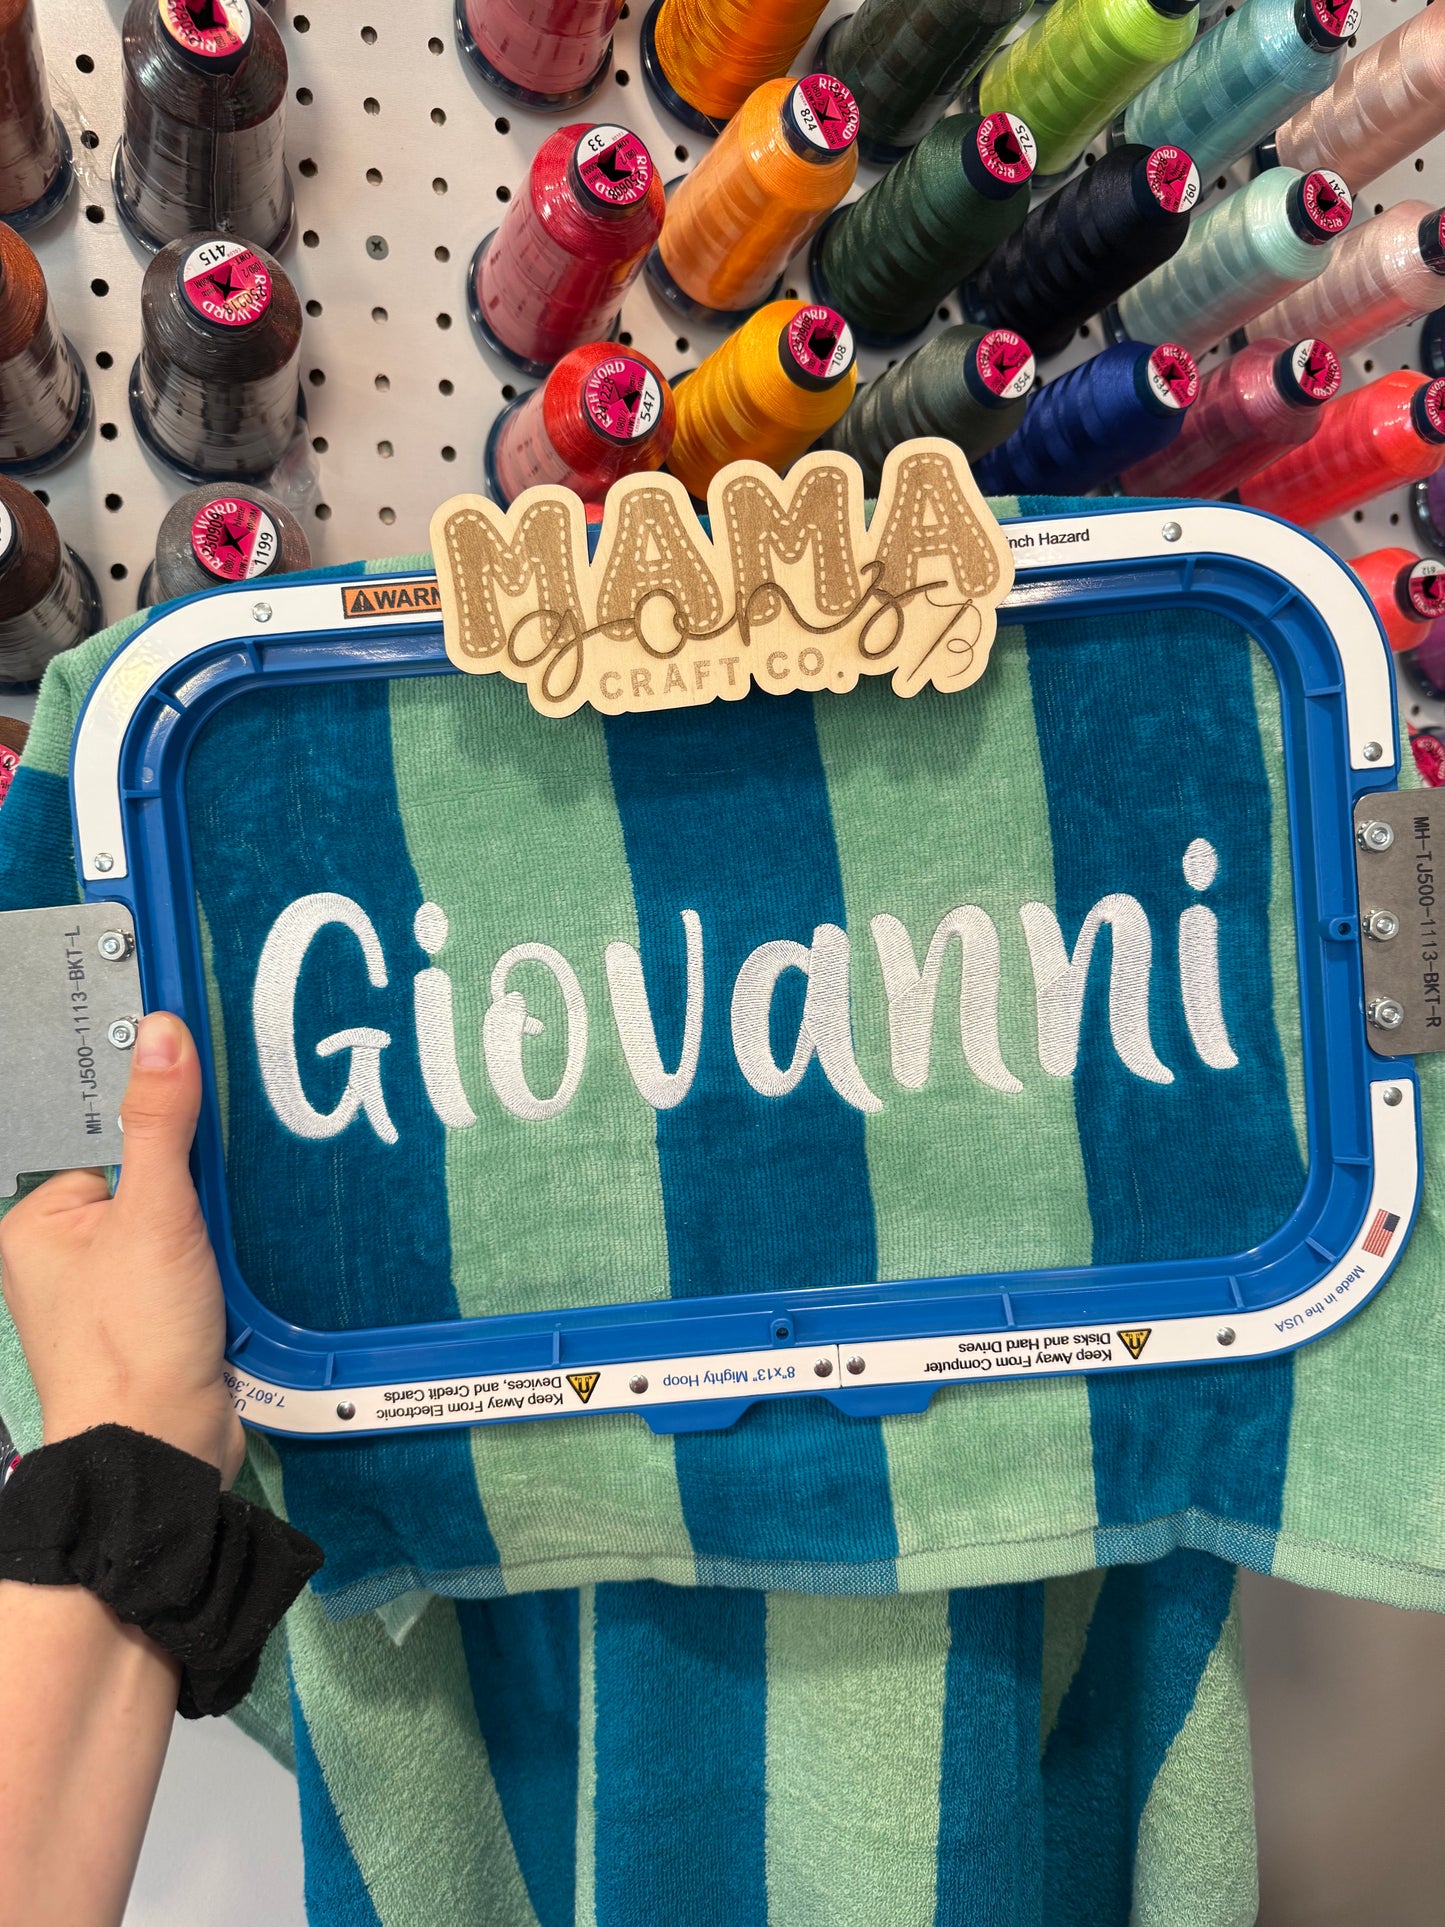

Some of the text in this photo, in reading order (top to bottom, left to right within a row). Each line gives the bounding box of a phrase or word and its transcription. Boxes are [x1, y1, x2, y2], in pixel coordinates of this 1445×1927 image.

[1345, 8, 1359, 30] 323
[800, 108, 818, 131] 824
[587, 134, 606, 152] 33
[1015, 124, 1033, 153] 725
[1183, 183, 1197, 205] 760
[1328, 179, 1346, 197] 247
[198, 244, 226, 266] 415
[832, 344, 847, 367] 108
[1296, 348, 1309, 368] 410
[588, 361, 626, 389] WORD
[1013, 372, 1031, 393] 854
[1152, 375, 1170, 397] 634
[640, 390, 655, 422] 547
[254, 531, 274, 566] 1199
[1038, 528, 1090, 546] Hazard
[444, 451, 1001, 659] MAMA
[600, 646, 845, 701] CRAFT CO.
[1413, 816, 1442, 1028] MH-TJ500-1113-BKT-R
[252, 837, 1239, 1144] Giovanni
[64, 925, 102, 1135] MH-TJ500-1113-BKT-L
[1274, 1265, 1365, 1332] Made in the USA
[958, 1332, 1111, 1354] Disks and Hard Drives
[924, 1348, 1112, 1374] Keep Away From Computer
[662, 1374, 699, 1387] Hoop
[703, 1368, 749, 1385] Mighty
[384, 1376, 562, 1404] Devices, and Credit Cards
[376, 1393, 564, 1421] Keep Away From Electronic
